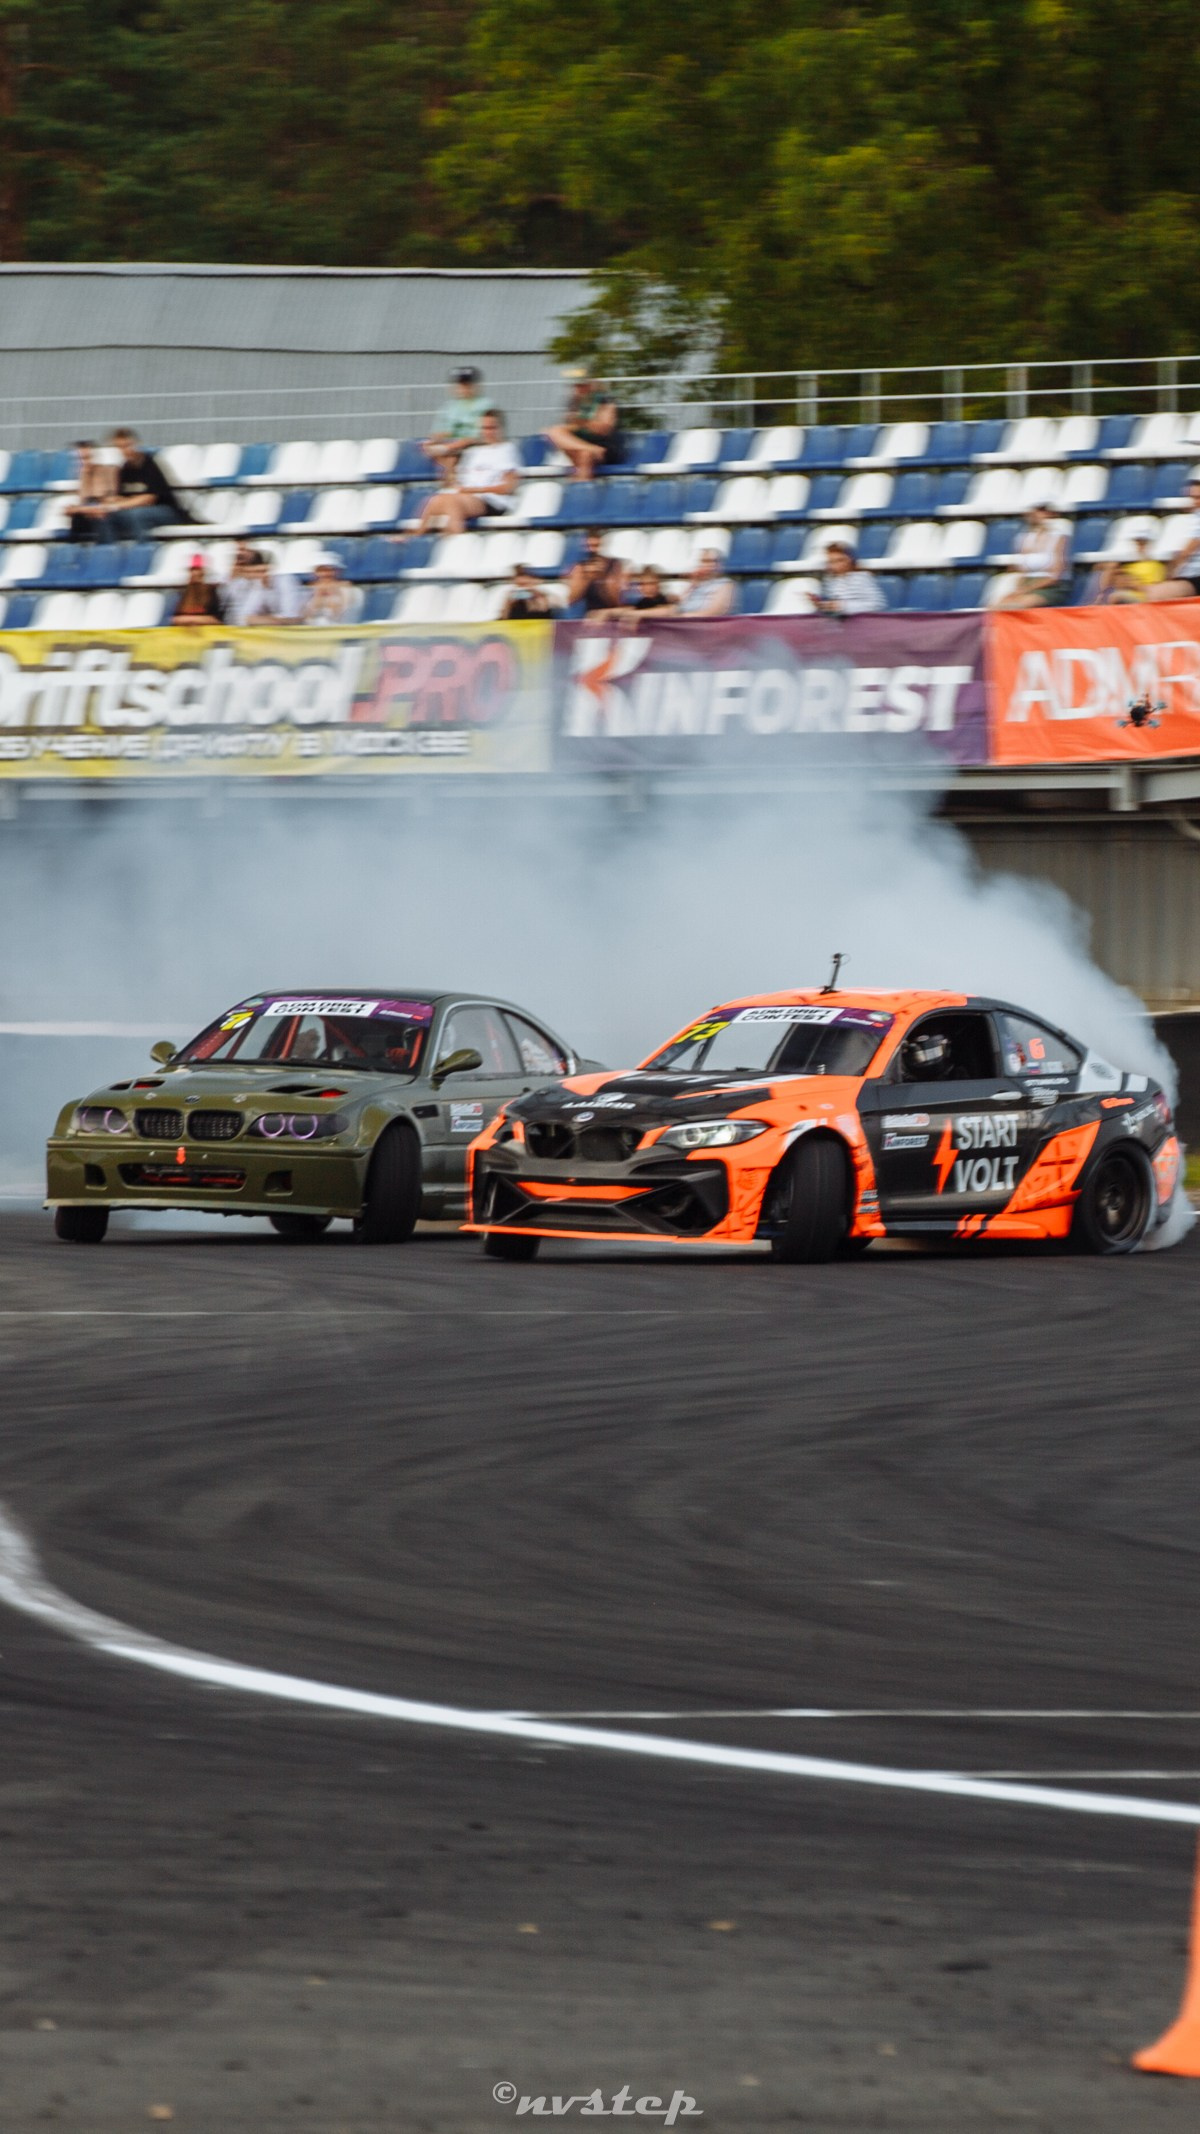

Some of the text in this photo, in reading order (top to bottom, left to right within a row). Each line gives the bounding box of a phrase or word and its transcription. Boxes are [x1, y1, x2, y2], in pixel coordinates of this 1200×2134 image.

[563, 637, 974, 738] KINFOREST
[956, 1114, 1019, 1150] START
[956, 1156, 1019, 1193] VOLT
